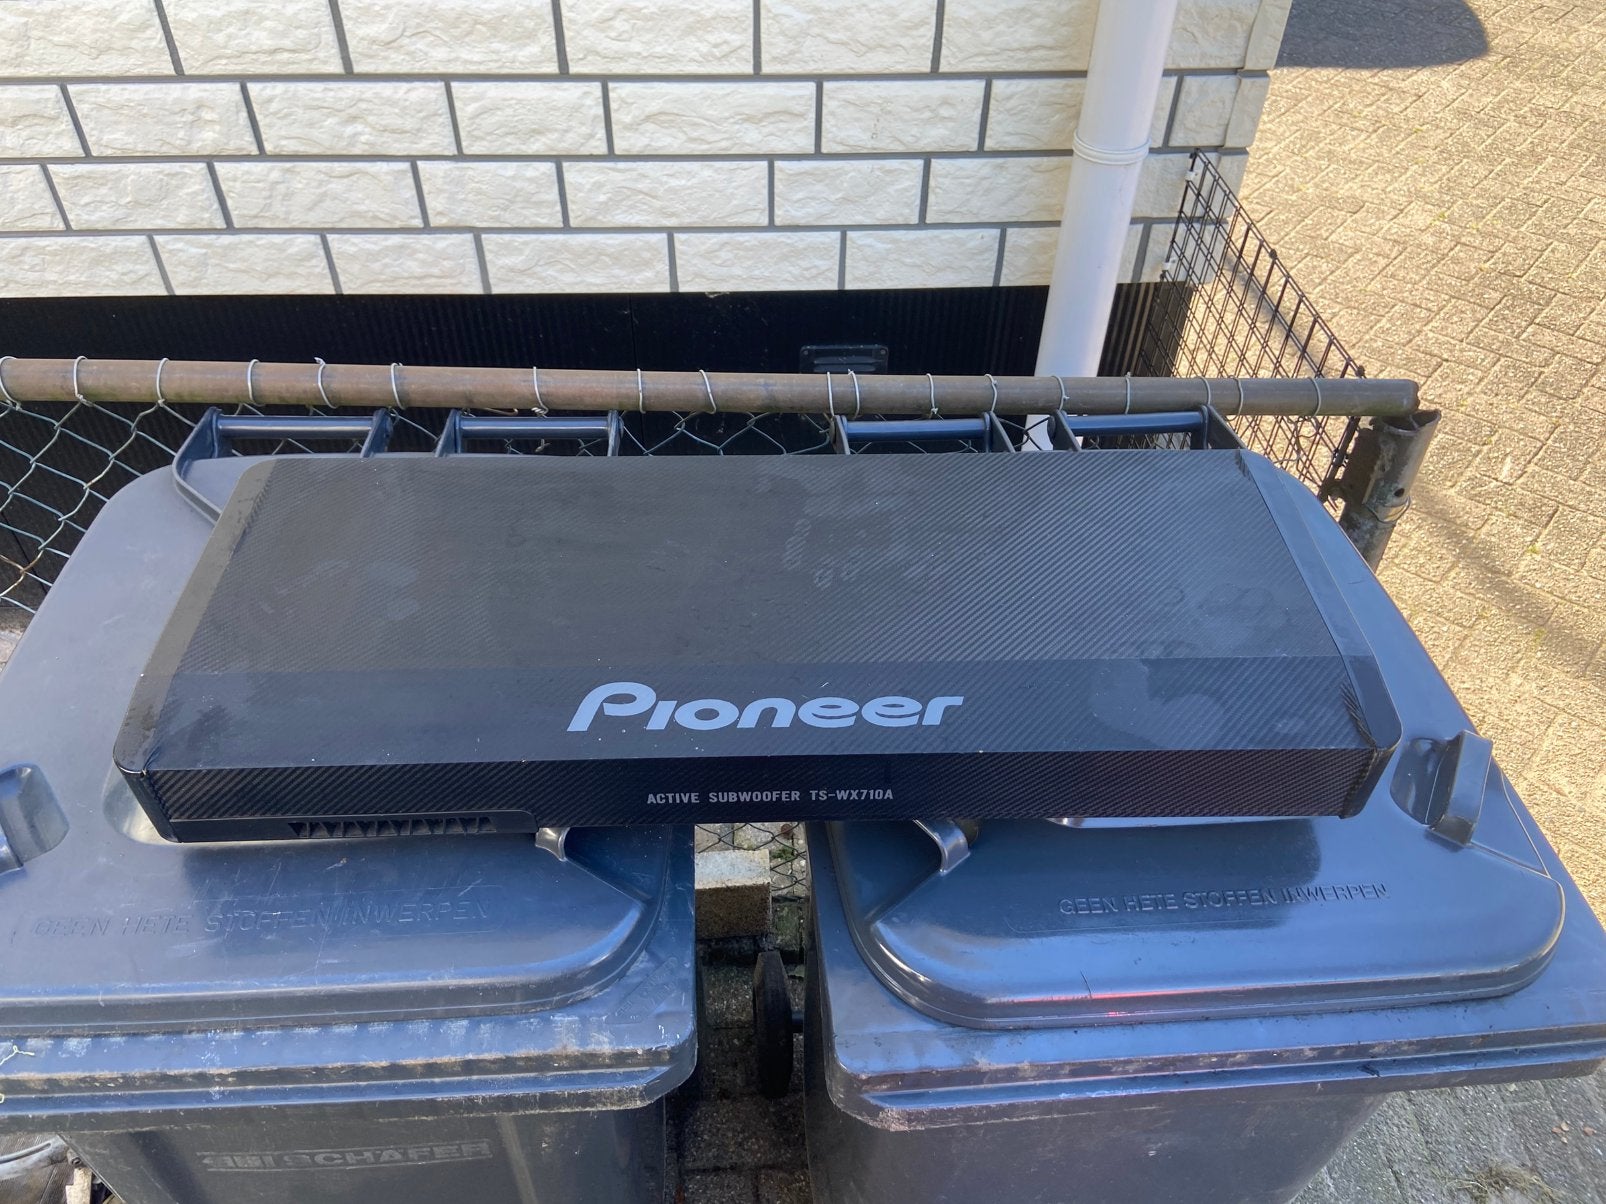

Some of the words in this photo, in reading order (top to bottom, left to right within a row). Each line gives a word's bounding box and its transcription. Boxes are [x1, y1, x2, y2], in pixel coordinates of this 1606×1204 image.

[567, 681, 965, 732] Pioneer
[646, 792, 700, 805] ACTIVE
[708, 790, 801, 803] SUBWOOFER
[809, 788, 894, 801] TS-WX710A
[1058, 896, 1119, 916] GEEN
[1124, 893, 1180, 912] HETE
[1183, 888, 1278, 910] STOFFEN
[1281, 881, 1392, 904] INWERPEN
[121, 913, 193, 935] HETE
